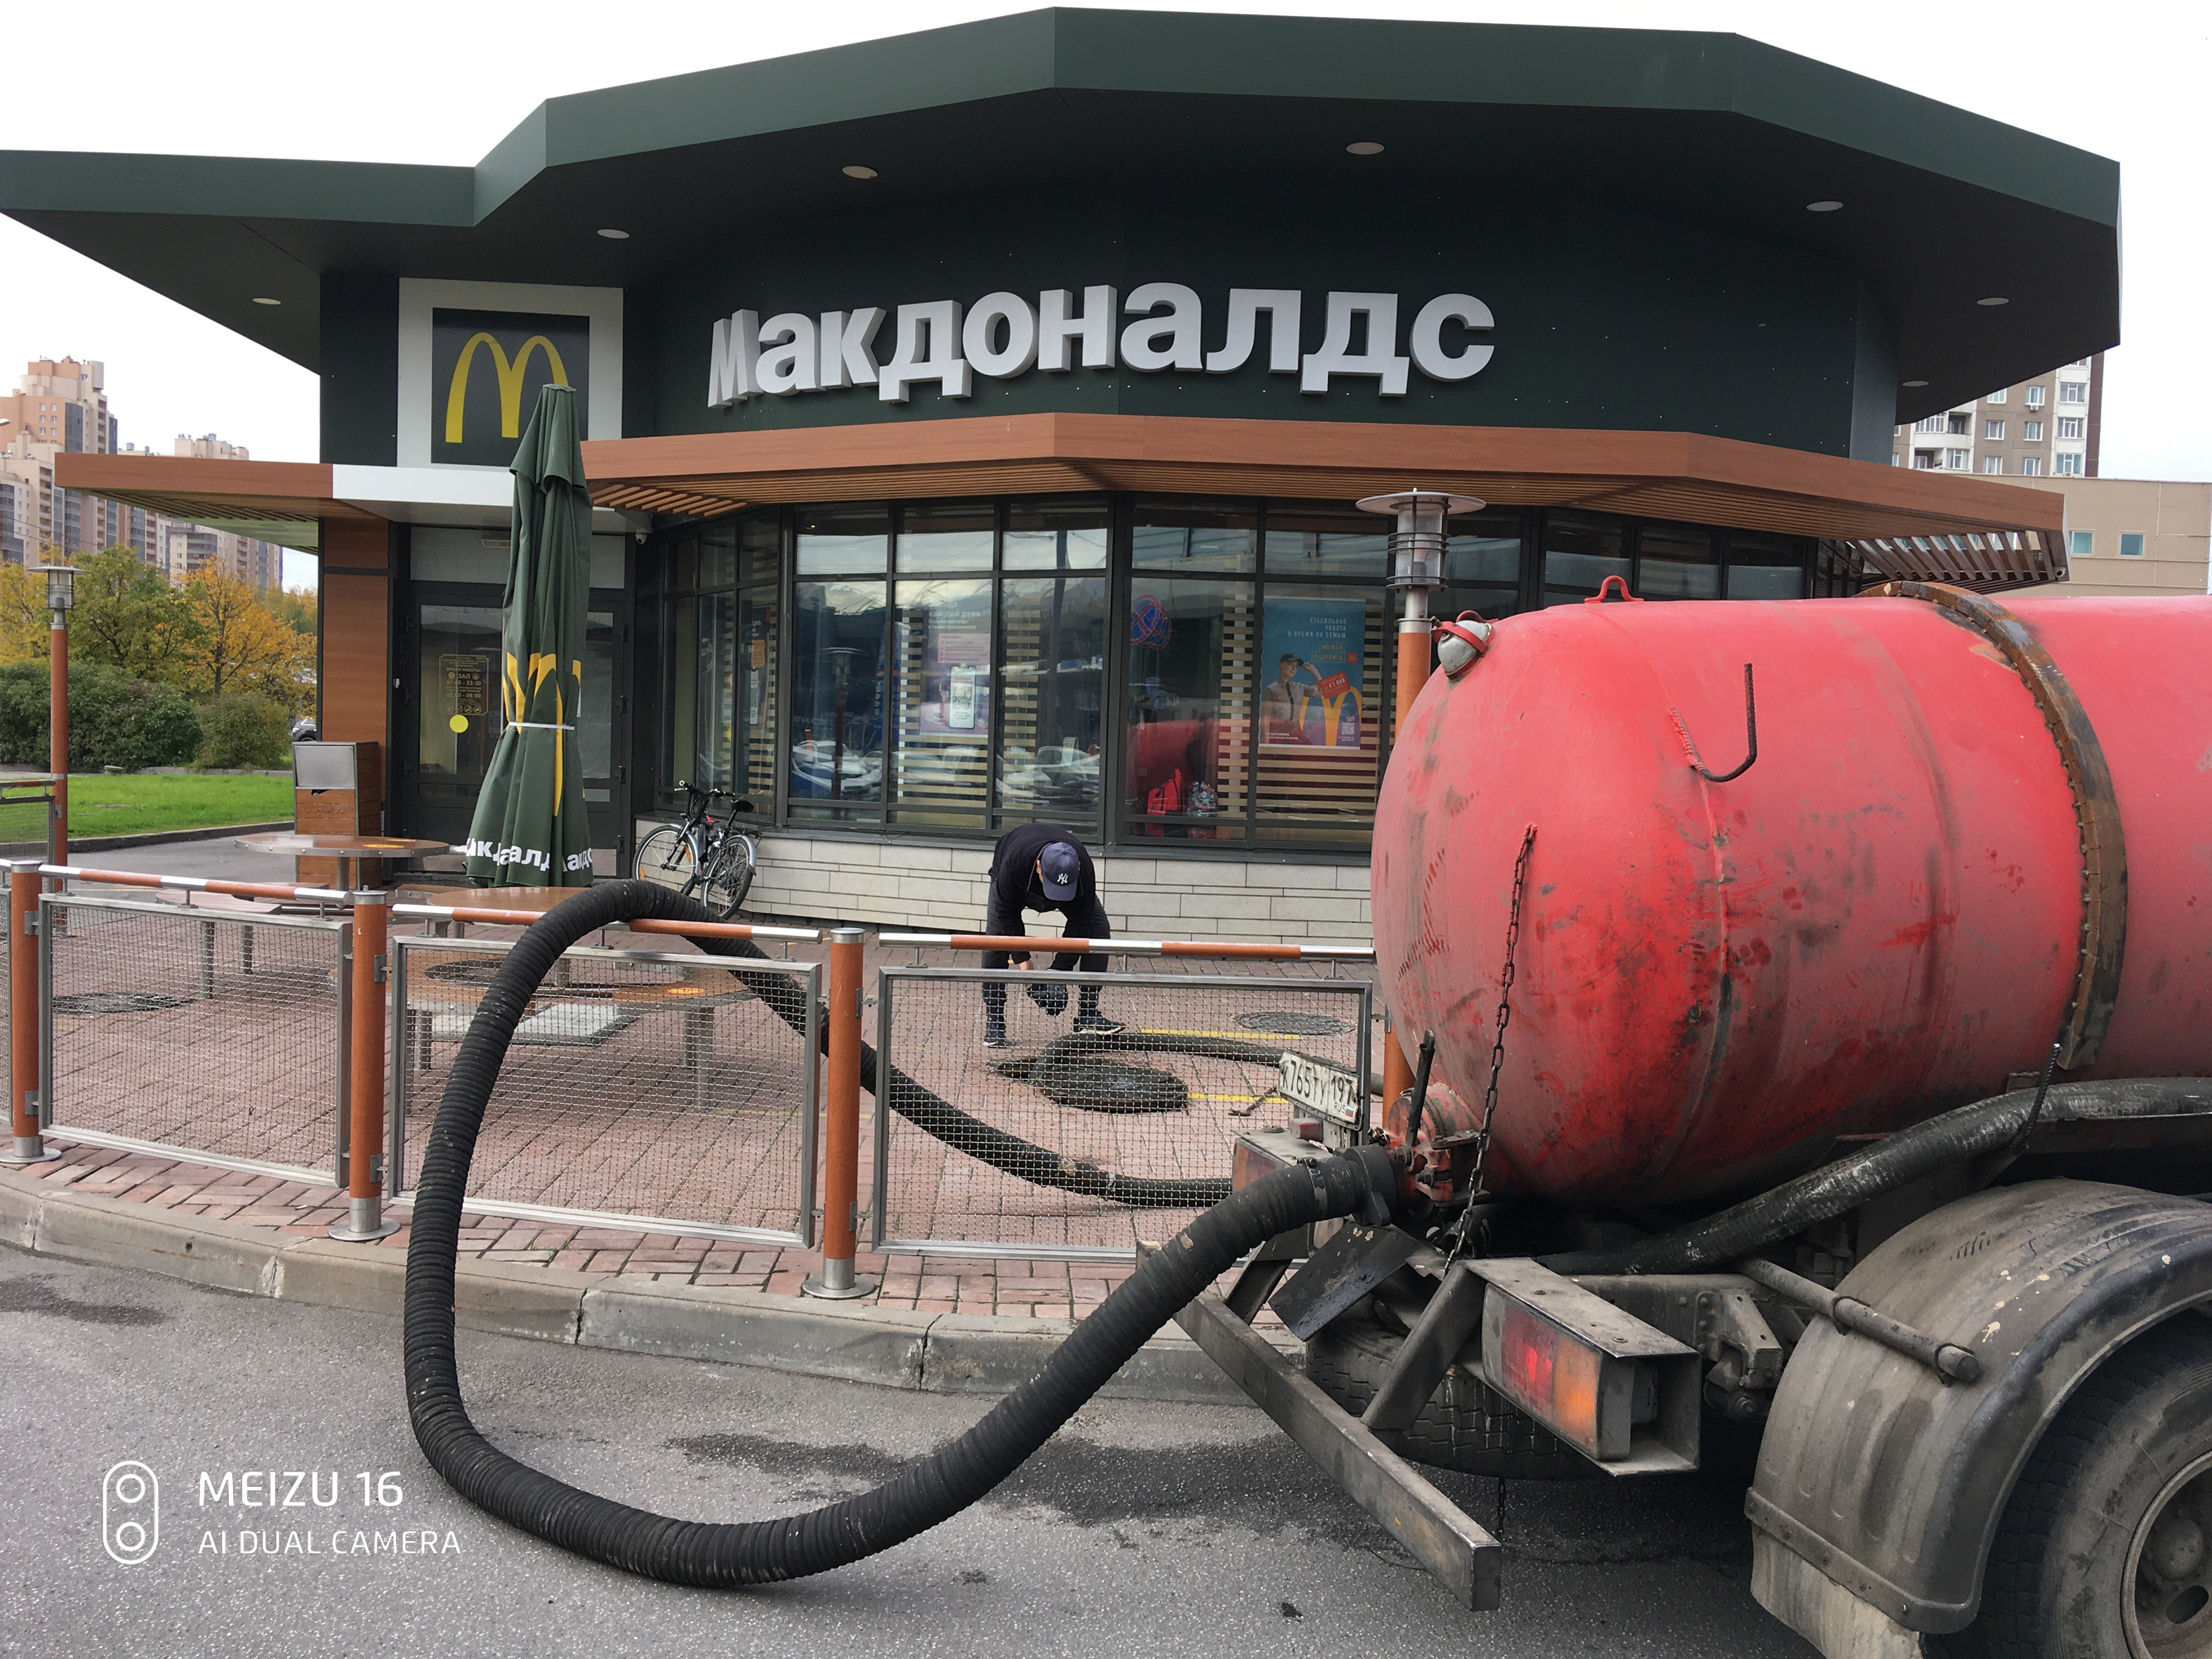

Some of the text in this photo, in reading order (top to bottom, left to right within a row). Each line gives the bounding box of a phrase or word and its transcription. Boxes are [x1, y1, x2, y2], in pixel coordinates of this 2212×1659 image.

[707, 282, 1496, 409] Макдоналдс
[928, 610, 960, 618] каждый
[1057, 873, 1068, 884] NY
[1331, 1075, 1352, 1105] 197
[1334, 1101, 1346, 1113] RUS
